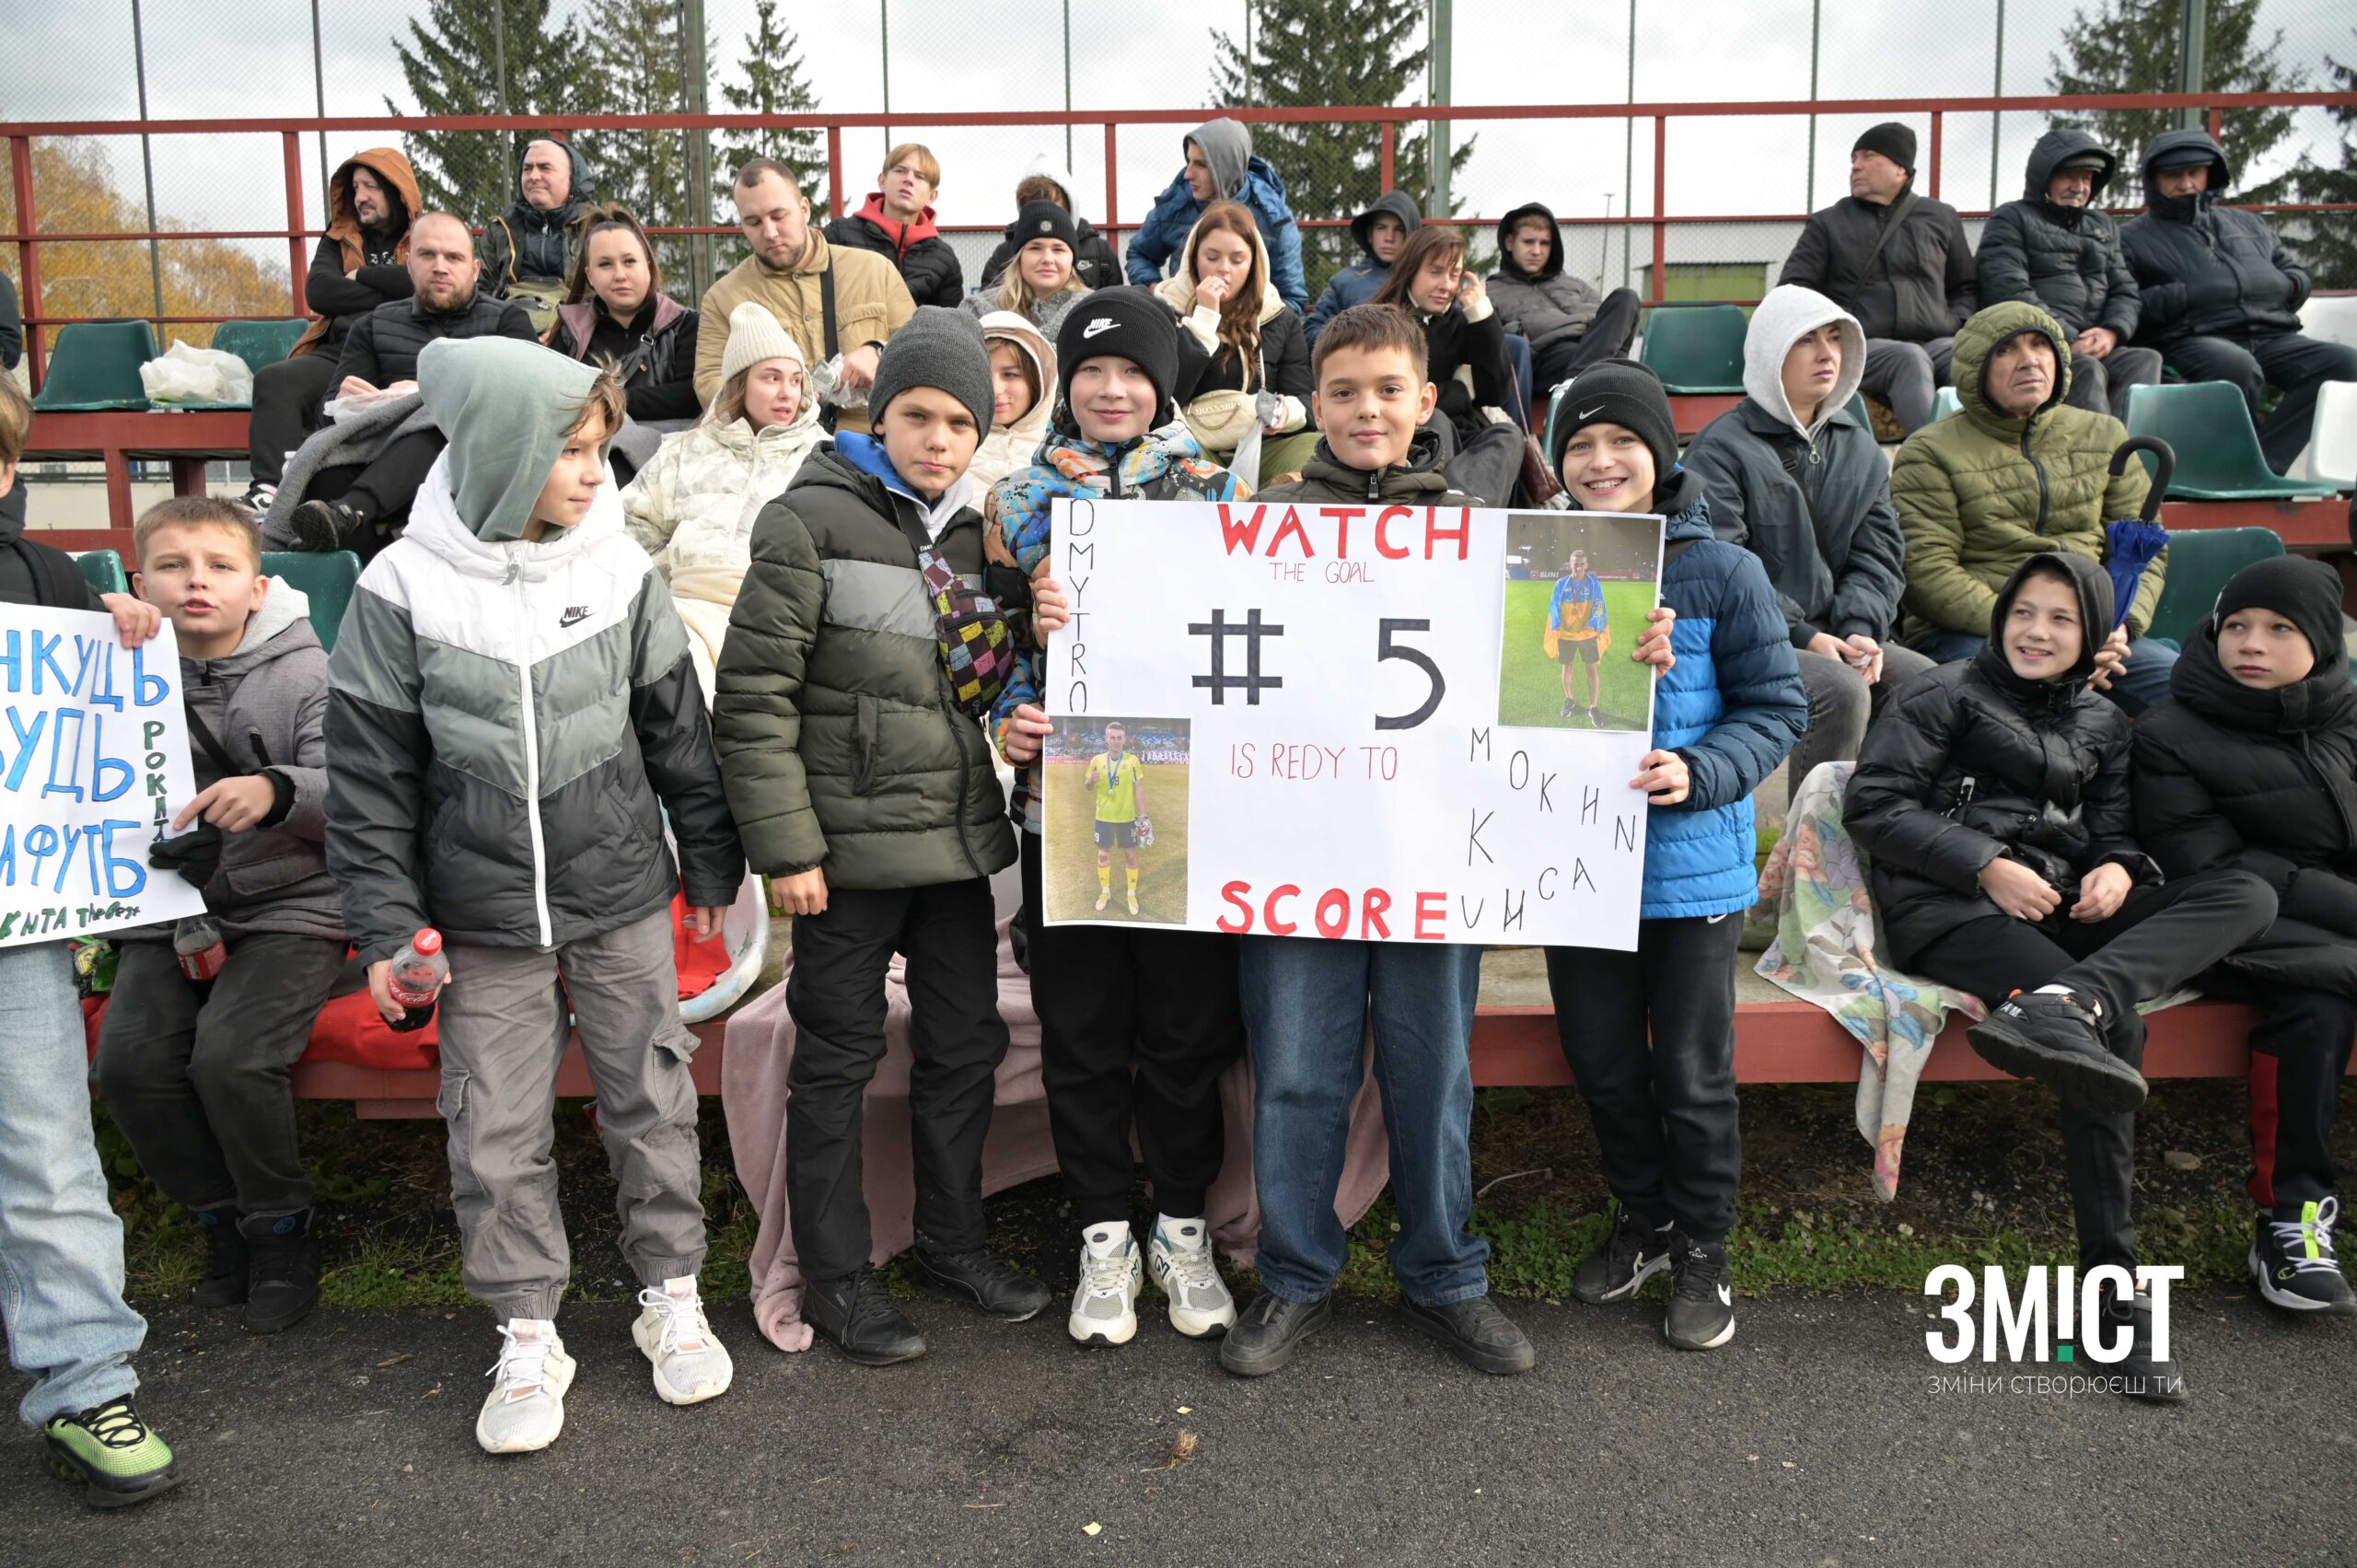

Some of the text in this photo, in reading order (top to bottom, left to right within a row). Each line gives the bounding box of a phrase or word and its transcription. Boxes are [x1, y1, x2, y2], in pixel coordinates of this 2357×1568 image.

[1217, 504, 1470, 561] WATCH
[1269, 561, 1375, 584] THE GOAL
[563, 606, 589, 619] NIKE
[1069, 498, 1095, 713] DMYTRO
[1375, 619, 1446, 730] 5
[0, 705, 135, 803] УДЬ
[1231, 742, 1399, 781] IS REDY TO
[1215, 880, 1447, 940] SCORE
